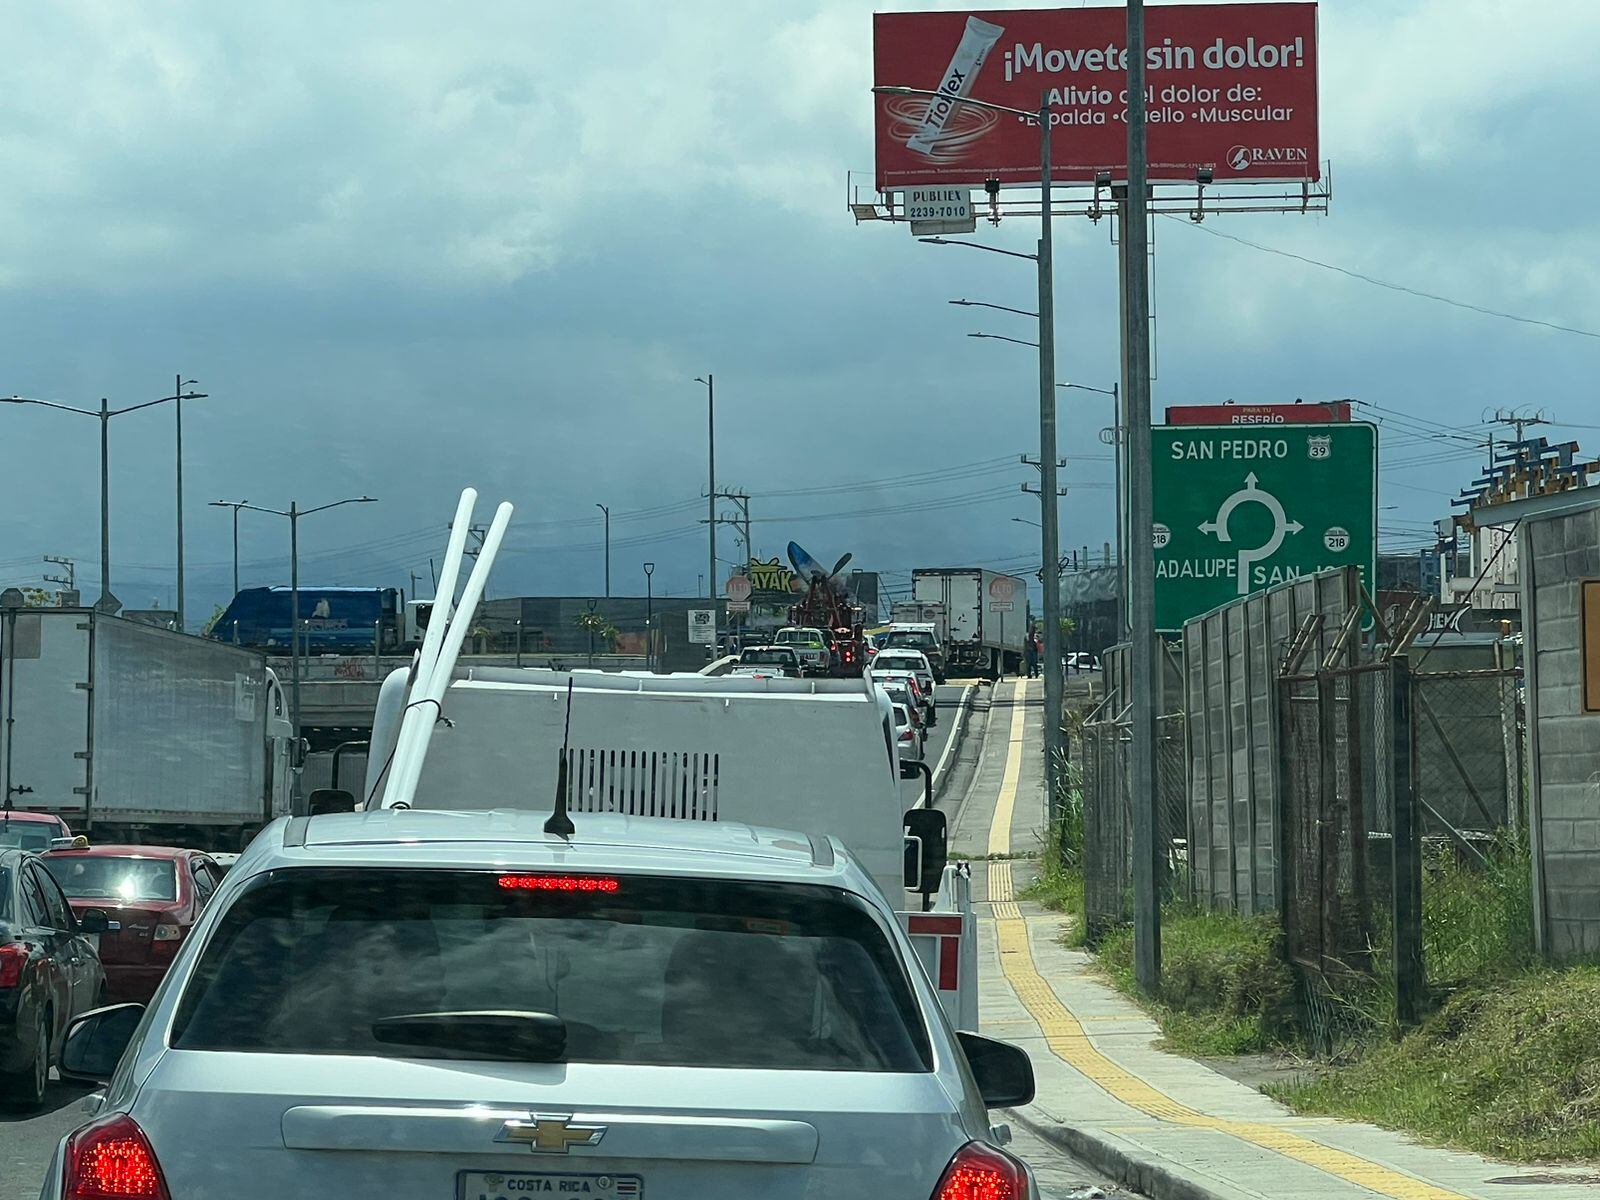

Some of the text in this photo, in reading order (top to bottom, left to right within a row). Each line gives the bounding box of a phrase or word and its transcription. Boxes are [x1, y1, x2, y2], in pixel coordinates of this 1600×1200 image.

[1146, 38, 1195, 70] sin
[1203, 36, 1304, 69] dolor!
[1048, 85, 1113, 105] Alivio
[1160, 85, 1220, 104] dolor
[1226, 83, 1262, 102] de:
[1200, 105, 1293, 122] Muscular
[1252, 147, 1308, 161] RAVEN
[913, 190, 962, 202] PUBLIEX
[910, 206, 966, 218] 2239-7010
[1171, 440, 1288, 460] SAN PEDRO
[1311, 446, 1326, 457] 39
[1328, 537, 1346, 548] 218
[1254, 565, 1300, 585] SAN
[728, 583, 749, 593] ALTO
[991, 584, 1012, 594] ALTO
[507, 1179, 591, 1193] COSTA RICA
